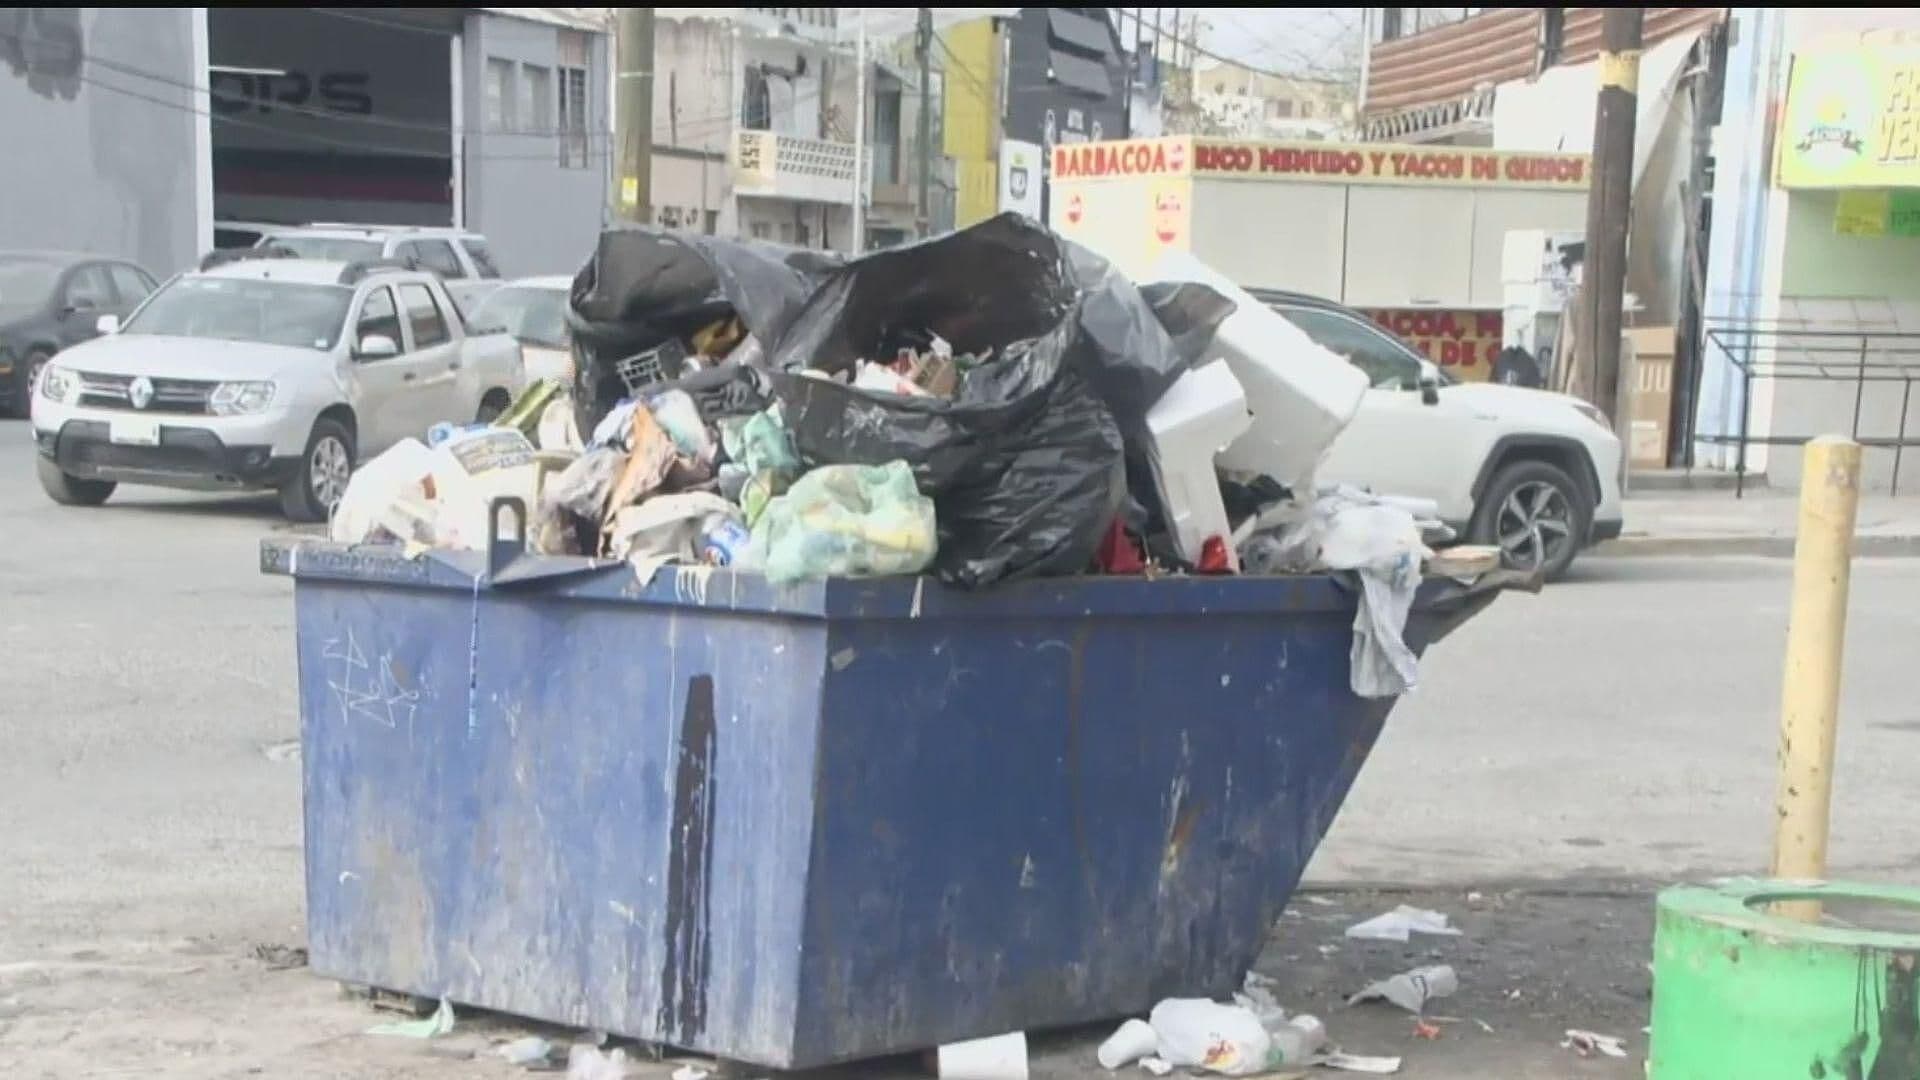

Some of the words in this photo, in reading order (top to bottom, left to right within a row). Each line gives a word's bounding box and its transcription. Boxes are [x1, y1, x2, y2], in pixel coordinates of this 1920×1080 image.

[1055, 143, 1167, 177] BARBACOA
[1195, 145, 1253, 171] RICO
[1258, 146, 1364, 176] MENUDO
[1369, 151, 1387, 176] Y
[1391, 152, 1465, 178] TACOS
[1471, 154, 1499, 180] DE
